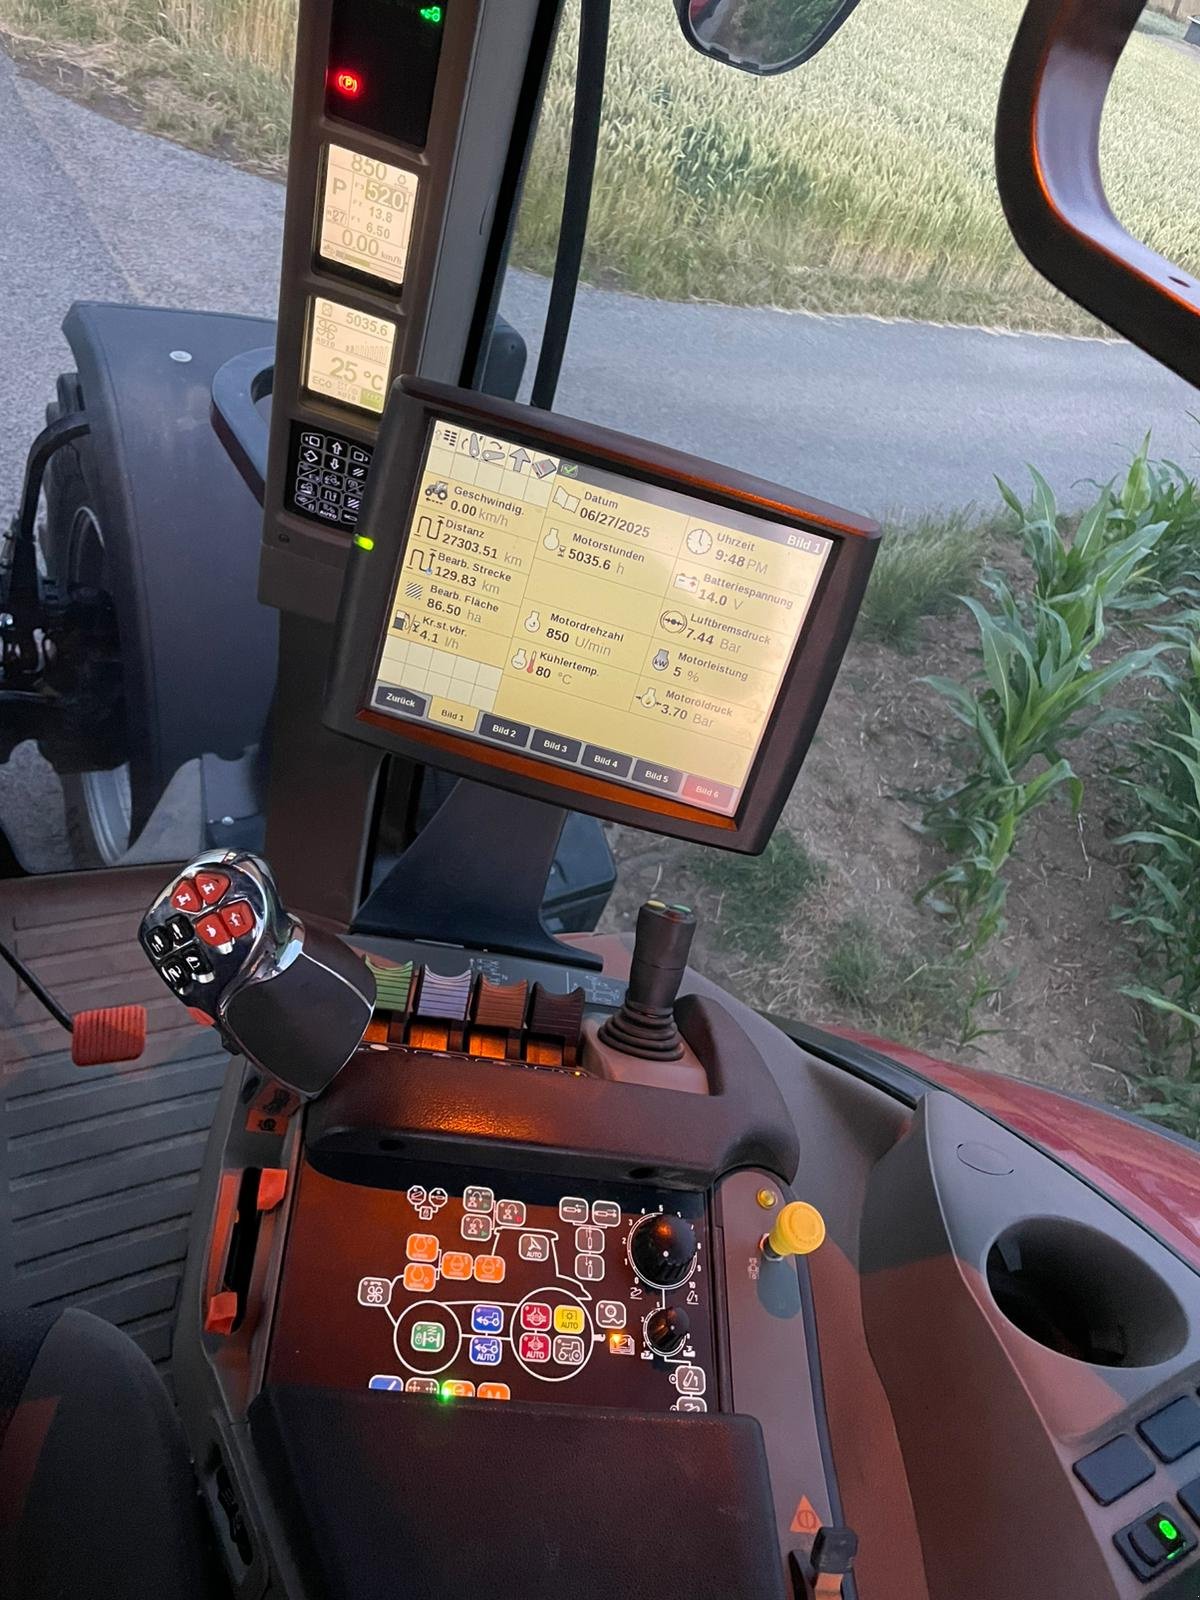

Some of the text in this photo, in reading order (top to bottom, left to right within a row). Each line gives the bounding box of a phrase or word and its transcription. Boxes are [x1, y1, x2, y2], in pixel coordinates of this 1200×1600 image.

[351, 154, 387, 181] 850
[332, 177, 347, 195] P
[367, 181, 404, 209] 520
[369, 206, 393, 224] 13.8
[366, 222, 390, 239] 6.50
[342, 229, 379, 256] 0.00
[346, 312, 389, 337] 5035.6
[329, 356, 358, 383] 25
[363, 371, 384, 391] °C
[454, 486, 524, 516] Geschwindig.
[584, 491, 619, 509] Datum
[450, 500, 509, 527] 0.00 km/h
[579, 507, 650, 538] 06/27/2025
[446, 520, 485, 539] Distanz
[442, 533, 522, 568] 27303.51 km
[572, 533, 645, 562] Motorstunden
[716, 532, 755, 551] Uhrzeit
[786, 534, 821, 553] Bild 1
[438, 553, 512, 582] Bearb. Strecke
[568, 548, 625, 575] 5035.6 h
[715, 550, 768, 575] 9:48 PM
[435, 566, 500, 595] 129.83 km
[430, 585, 461, 601] Bearb.
[700, 589, 744, 611] 14.0 V
[703, 573, 793, 610] Batteriespannung
[427, 599, 481, 623] 86.50 ha
[422, 616, 467, 636] Kr.st.vbr.
[550, 613, 624, 642] Motordrehzahl
[690, 613, 771, 646] Luftbremsdruck
[419, 630, 459, 649] 4.1 l/h
[546, 628, 612, 656] 850 U/min
[686, 628, 742, 654] 7.44 Bar
[535, 666, 572, 685] 80 °C
[673, 666, 699, 682] 5 %
[678, 652, 749, 681] Motorleistung
[386, 692, 416, 708] Zurück
[441, 709, 464, 722] Bild 1
[660, 704, 714, 729] 3.70 Bar
[492, 724, 517, 738] Bild 2
[543, 739, 568, 753] Bild 3
[594, 754, 618, 768] Bild 4
[645, 770, 669, 783] Bild 5
[696, 785, 719, 799] Bild 6
[526, 1250, 542, 1259] AUTO
[561, 1322, 579, 1330] AUTO
[477, 1353, 497, 1362] AUTO
[526, 1351, 545, 1360] AUTO
